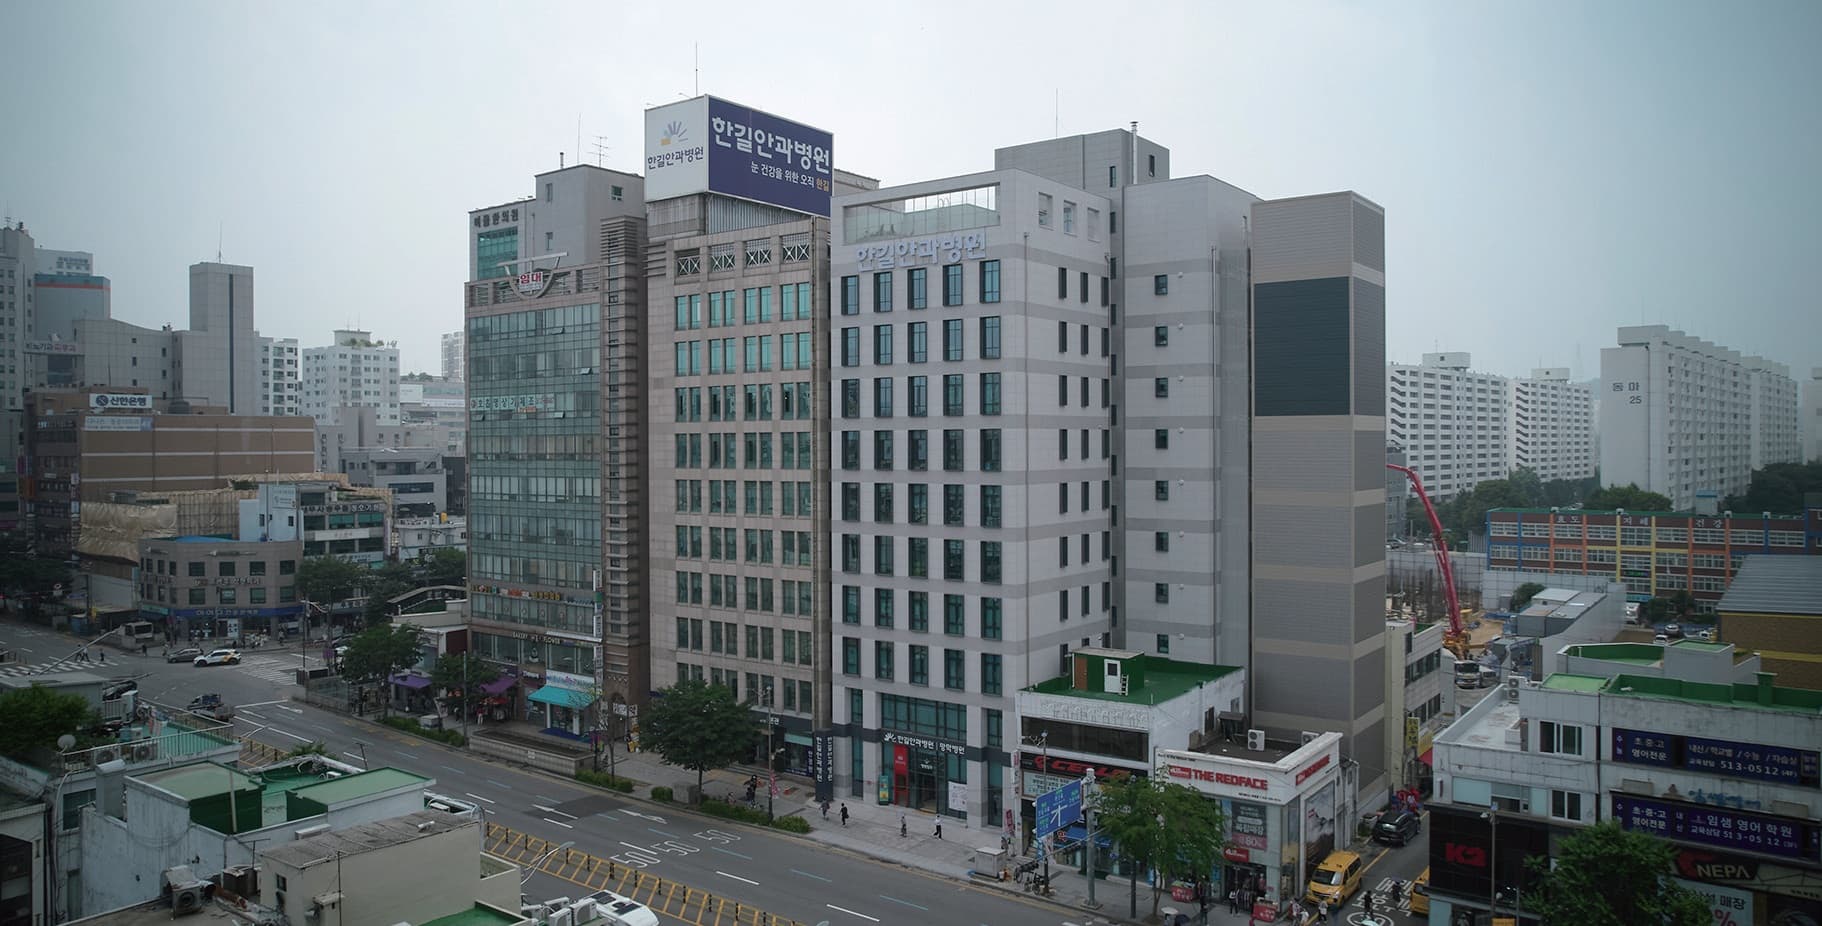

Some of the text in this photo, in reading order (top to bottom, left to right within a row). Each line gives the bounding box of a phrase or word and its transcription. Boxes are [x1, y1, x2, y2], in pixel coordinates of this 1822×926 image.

[711, 116, 830, 175] 한길안과병원
[648, 147, 704, 170] 한길안과병원
[750, 160, 830, 192] 눈 건강을 위한 오직 한길
[857, 229, 986, 272] 한길안과병원
[520, 272, 542, 285] 임대
[1629, 395, 1642, 404] 25
[1632, 748, 1666, 761] 영어전문
[1192, 769, 1268, 791] THE REDFACE
[1632, 816, 1666, 830] 영어전문
[1737, 819, 1761, 833] 영어
[1766, 824, 1793, 838] 학원
[692, 829, 742, 844] 50
[650, 840, 701, 856] 50
[1445, 842, 1487, 867] K2
[609, 851, 661, 868] 50
[1696, 863, 1751, 880] NEPA
[1720, 895, 1745, 910] 매장
